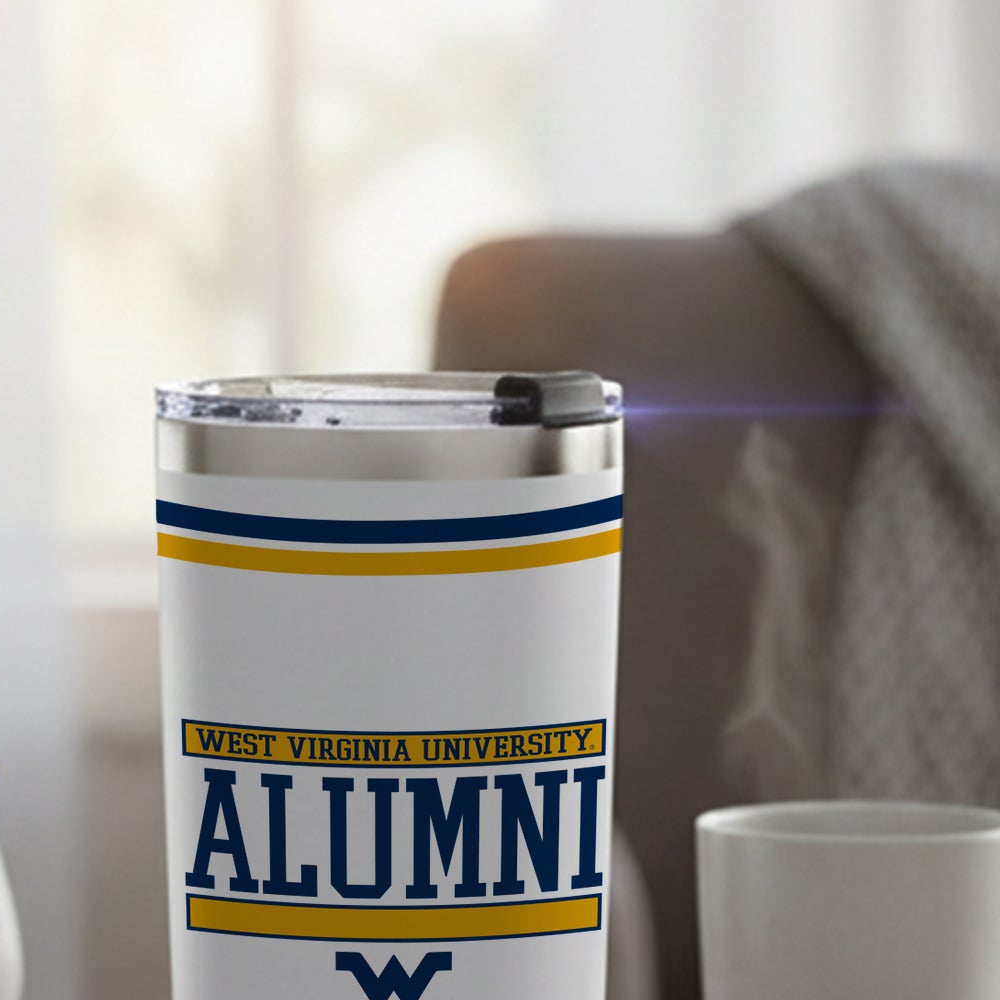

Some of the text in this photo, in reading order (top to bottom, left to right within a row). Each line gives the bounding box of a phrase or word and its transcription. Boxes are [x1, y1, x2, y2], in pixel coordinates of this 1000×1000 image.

[195, 727, 594, 762] WEST VIRGINIA UNIVERSITY
[185, 765, 606, 899] ALUMNI
